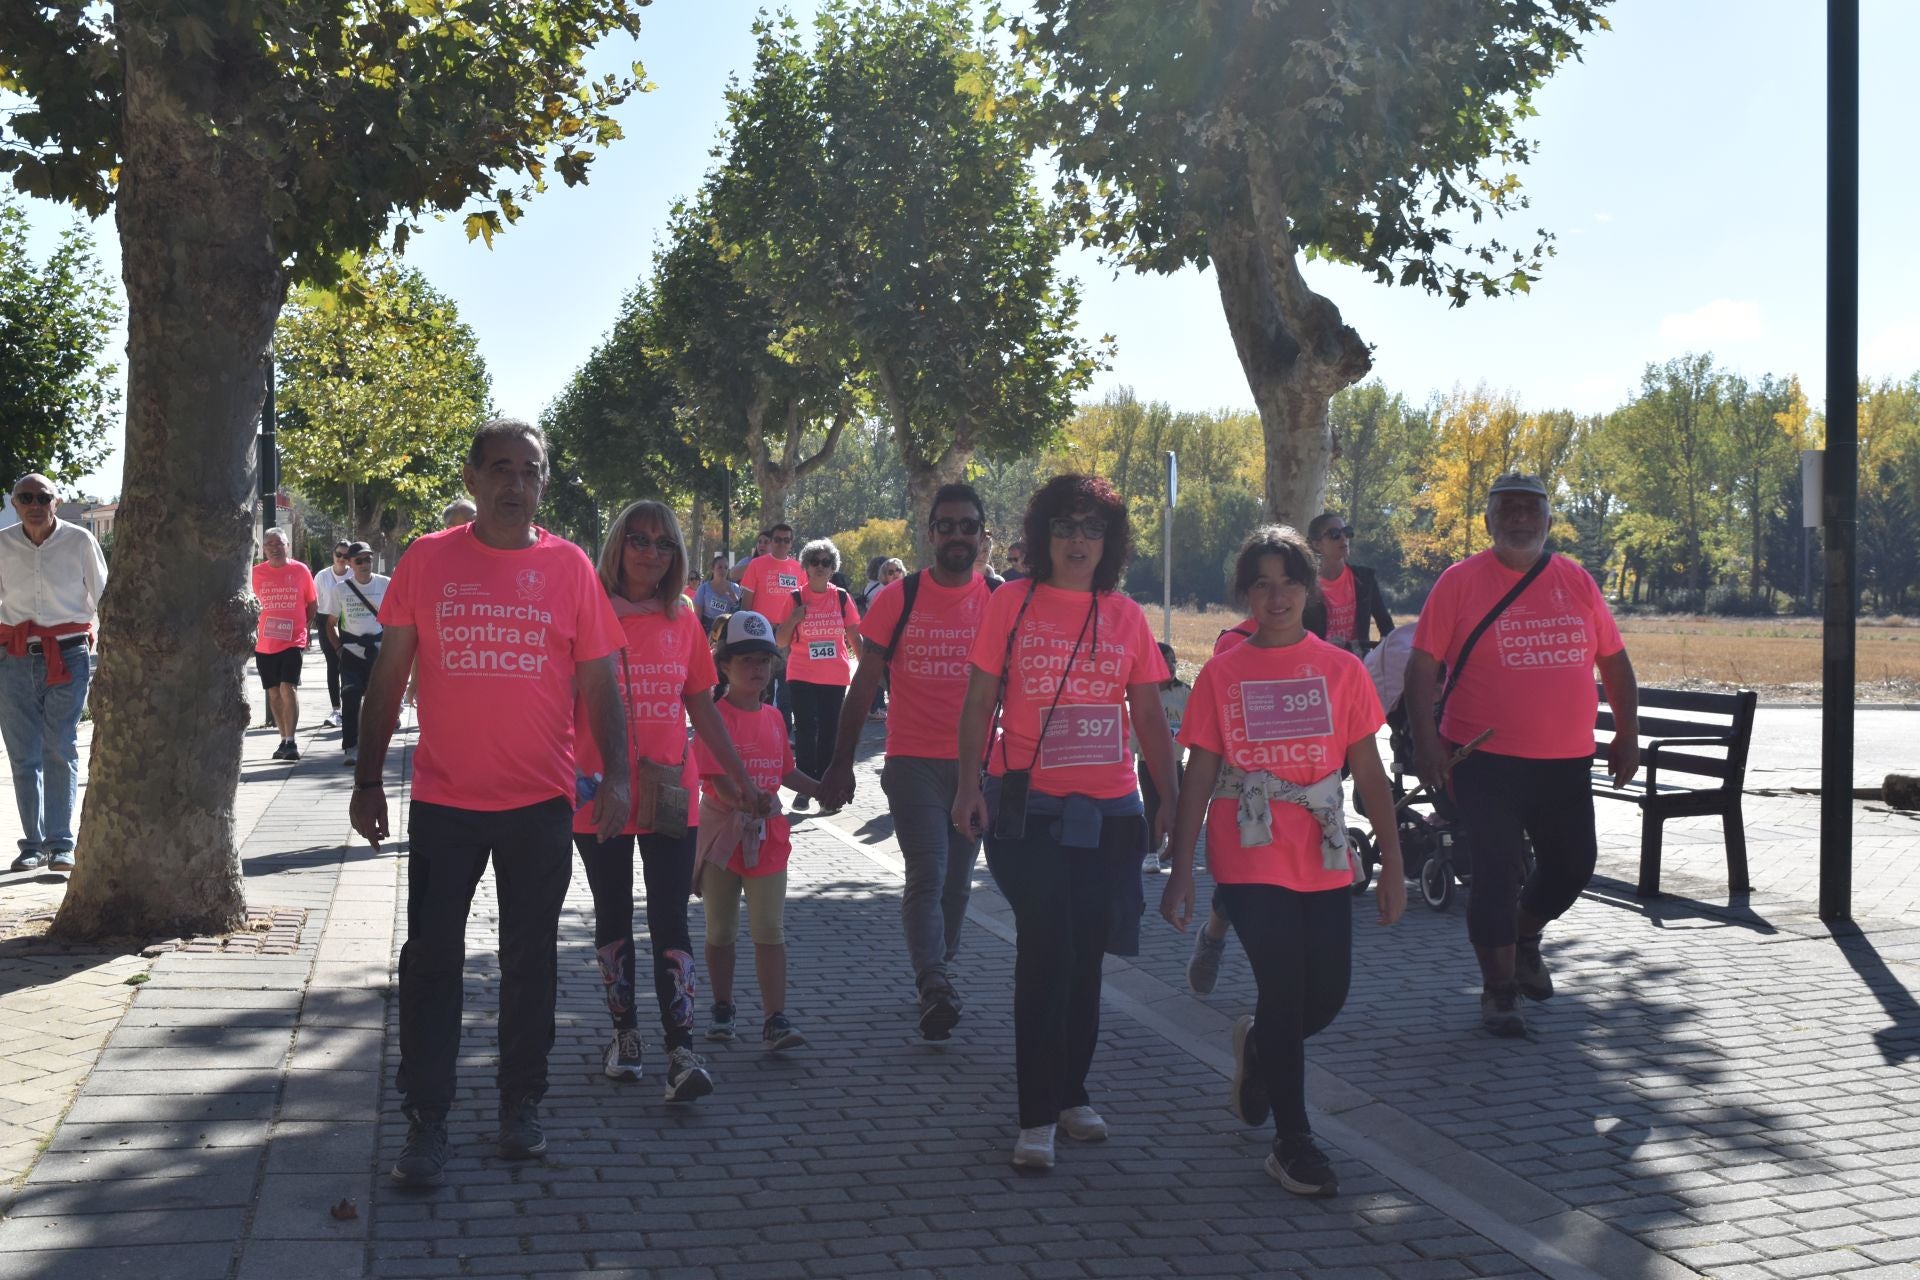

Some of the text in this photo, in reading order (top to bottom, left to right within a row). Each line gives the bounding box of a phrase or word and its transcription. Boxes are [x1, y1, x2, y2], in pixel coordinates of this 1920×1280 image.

[780, 578, 796, 587] 364
[262, 593, 288, 601] contra
[263, 600, 297, 609] cáncer
[441, 600, 552, 625] En marcha
[803, 618, 836, 628] contra
[906, 624, 977, 639] En march
[1501, 614, 1585, 631] En marcha
[442, 622, 547, 648] contra el
[1022, 633, 1125, 656] En marcha
[1502, 627, 1588, 648] contra el
[445, 643, 549, 673] cáncer
[811, 647, 835, 658] 348
[905, 642, 967, 657] contra
[1506, 647, 1589, 667] cáncer
[907, 657, 973, 676] cánce
[1021, 653, 1122, 677] contra el
[617, 678, 672, 696] ontra
[1024, 669, 1119, 698] cáncer
[1281, 688, 1322, 712] 398
[1076, 718, 1115, 737] 397
